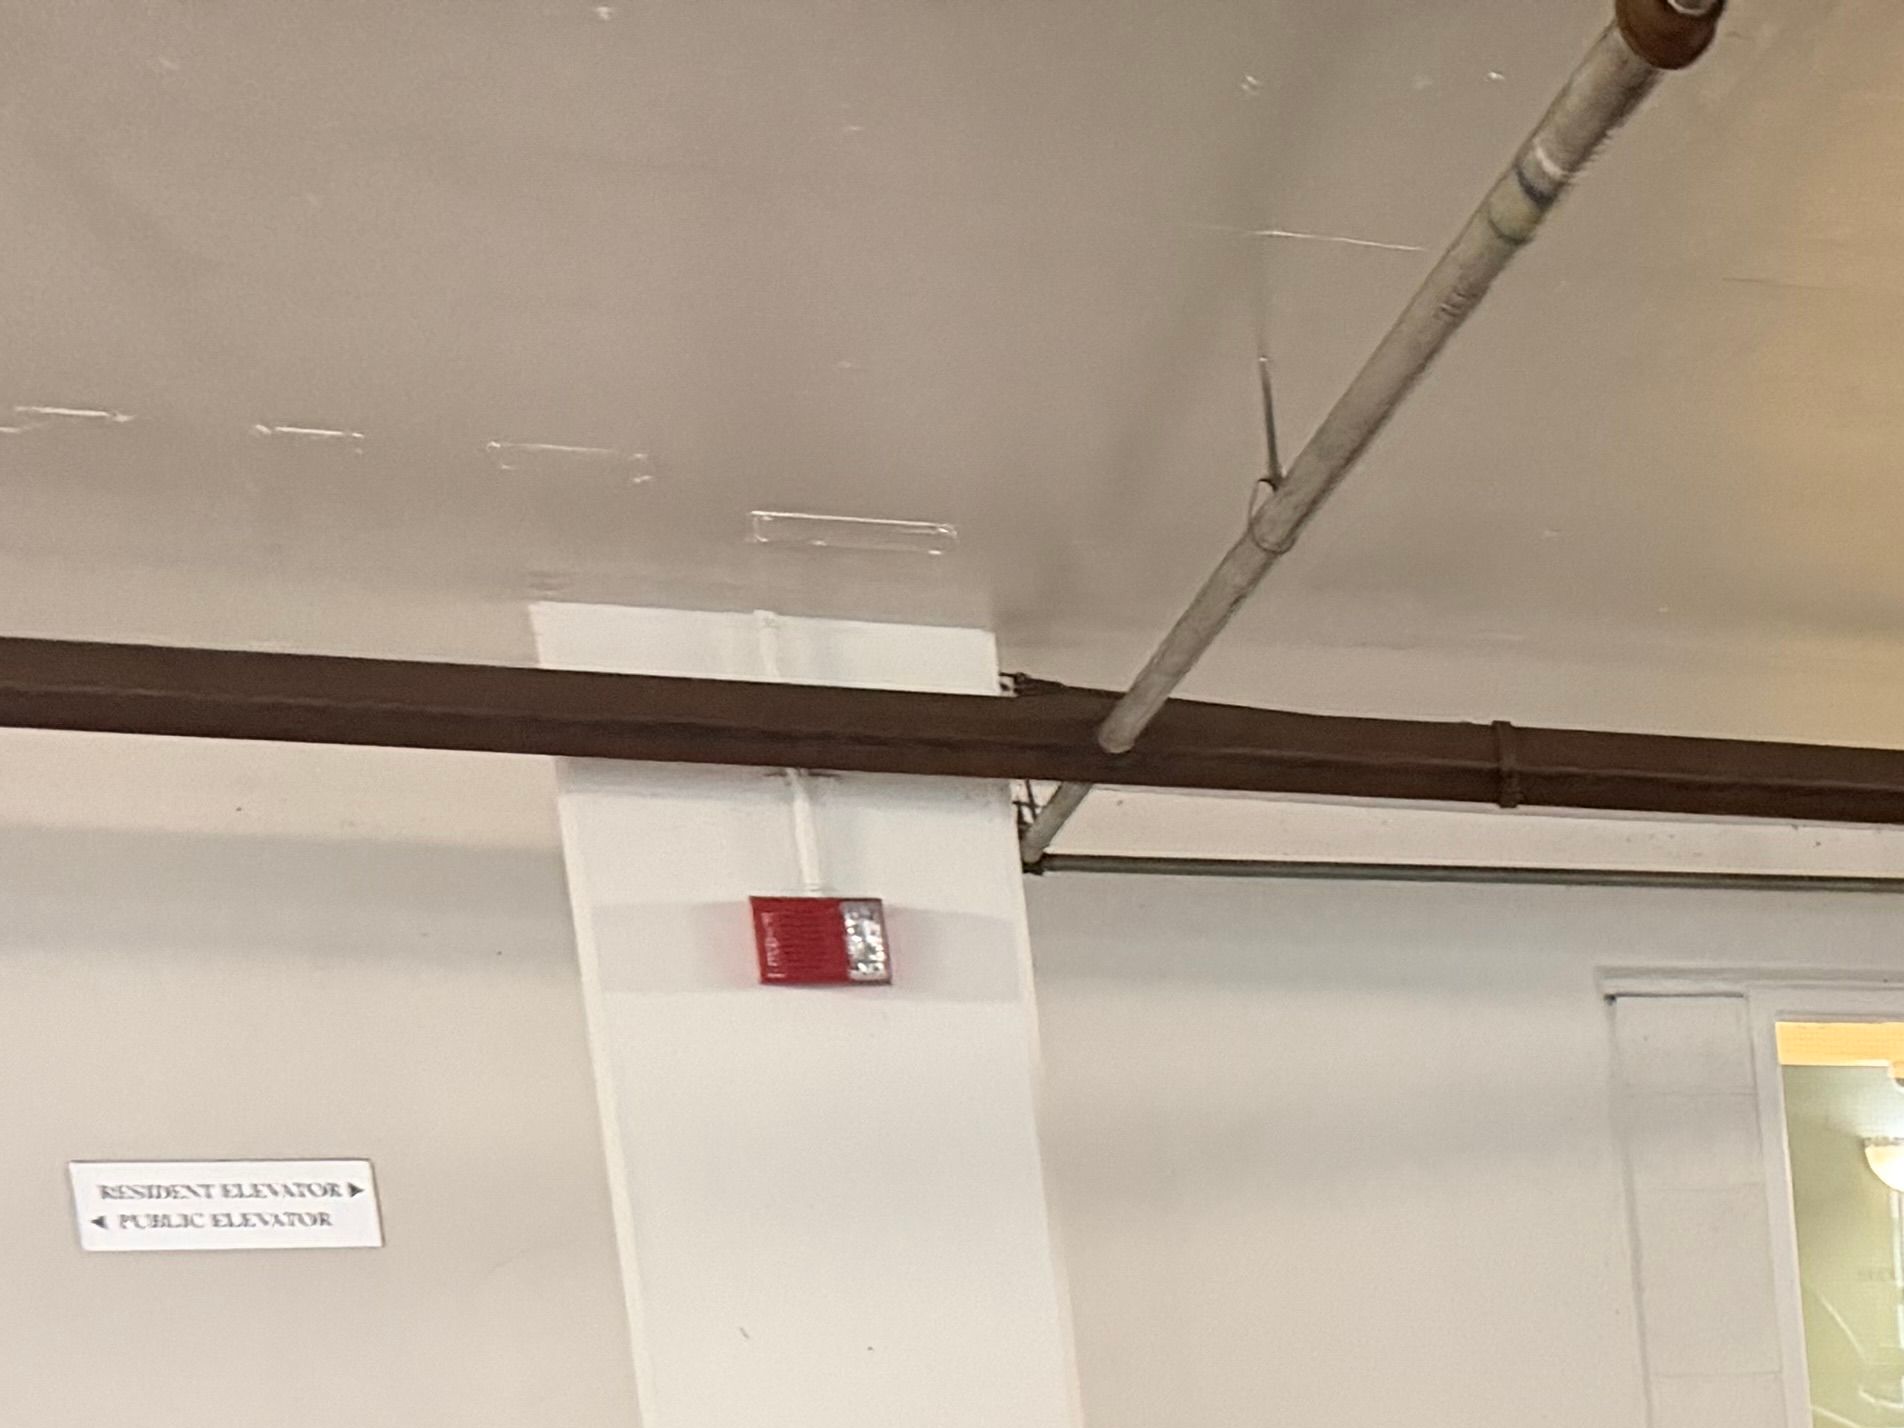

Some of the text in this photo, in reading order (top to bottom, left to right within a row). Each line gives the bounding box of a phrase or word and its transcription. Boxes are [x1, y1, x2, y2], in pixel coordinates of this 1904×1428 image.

[99, 1182, 343, 1200] RESIDENT ELEVATOR
[119, 1212, 333, 1230] PUBLIC ELEVATOR
